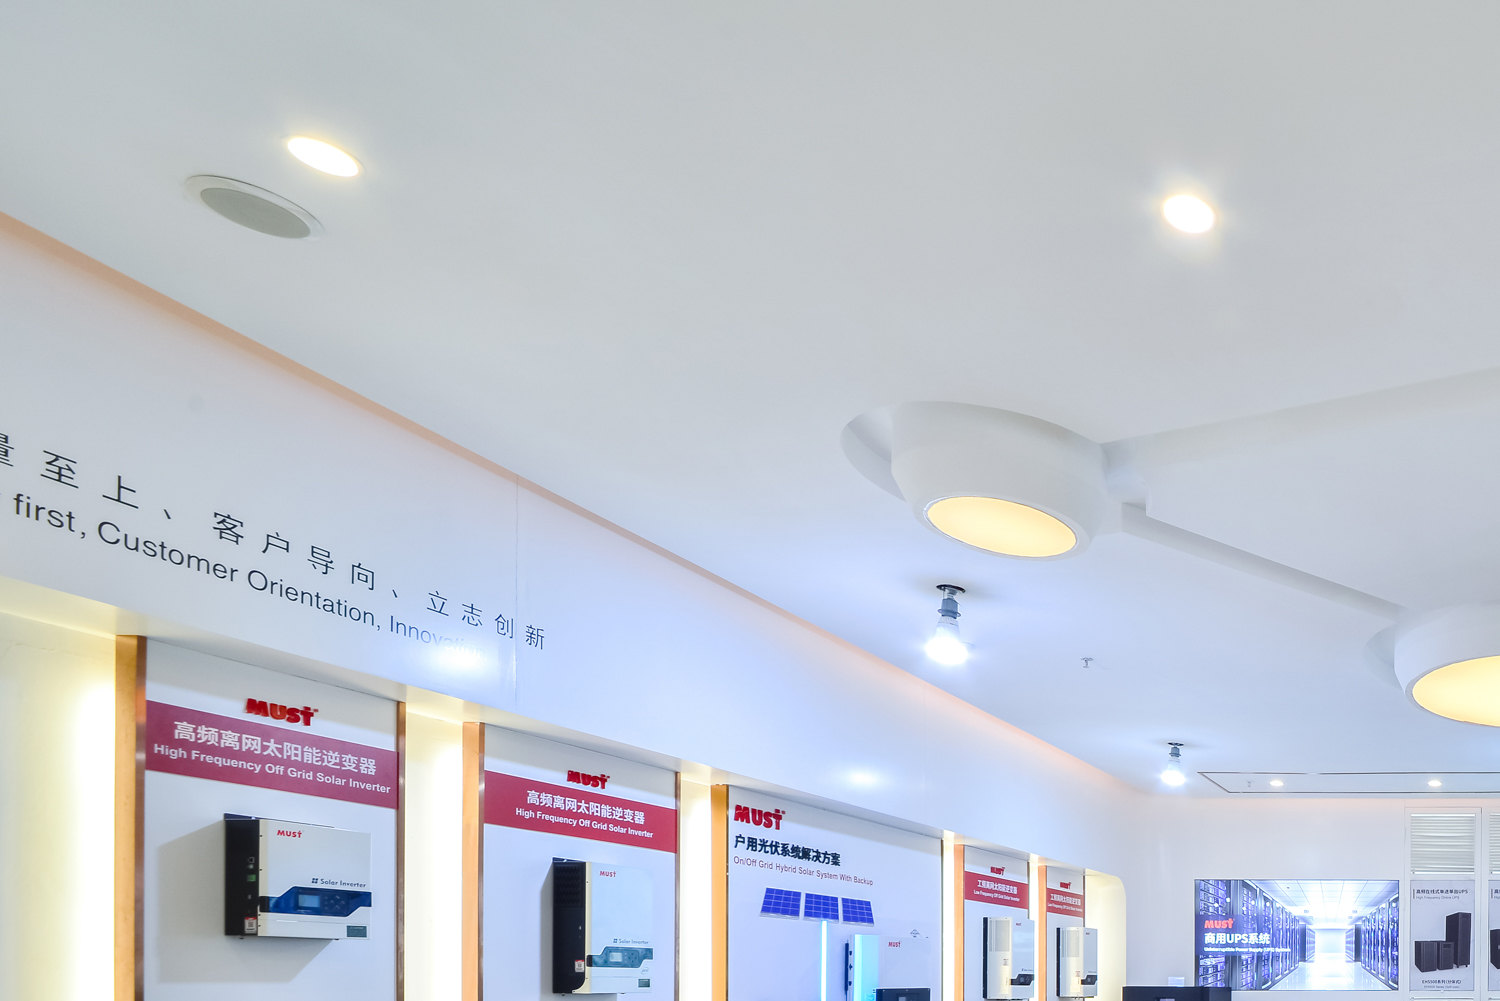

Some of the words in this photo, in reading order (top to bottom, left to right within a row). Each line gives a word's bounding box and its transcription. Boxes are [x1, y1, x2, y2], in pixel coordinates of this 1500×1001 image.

[13, 494, 87, 540] first,
[98, 520, 239, 583] Customer
[247, 570, 382, 632] Orientation,
[245, 698, 315, 726] MUST
[174, 721, 376, 775] 高频离网太阳能逆变器
[154, 743, 187, 759] High
[191, 750, 262, 774] Frequency
[265, 763, 284, 775] Off
[287, 768, 313, 780] Grid
[317, 772, 346, 786] Solar
[349, 778, 391, 793] Inverter
[567, 770, 607, 789] MUST
[527, 790, 645, 824] 高频离网太阳能逆变器
[734, 804, 782, 830] MUST
[277, 829, 302, 838] MUST
[516, 807, 534, 819] High
[537, 811, 577, 827] Frequency
[579, 819, 590, 828] Off
[592, 821, 607, 831] Grid
[609, 824, 626, 834] Solar
[628, 827, 653, 838] Inverter
[735, 834, 840, 866] 户用光伏系统解决方案
[320, 878, 338, 887] Solar
[340, 880, 366, 888] Inverter
[734, 856, 756, 867] On/Off
[759, 860, 773, 870] Grid
[776, 863, 796, 874] Hybrid
[799, 866, 814, 876] Solar
[816, 870, 838, 881] System
[840, 874, 852, 882] With
[854, 876, 873, 886] Backup
[1204, 918, 1233, 928] MUST
[1204, 933, 1270, 944] 商用UPS系统
